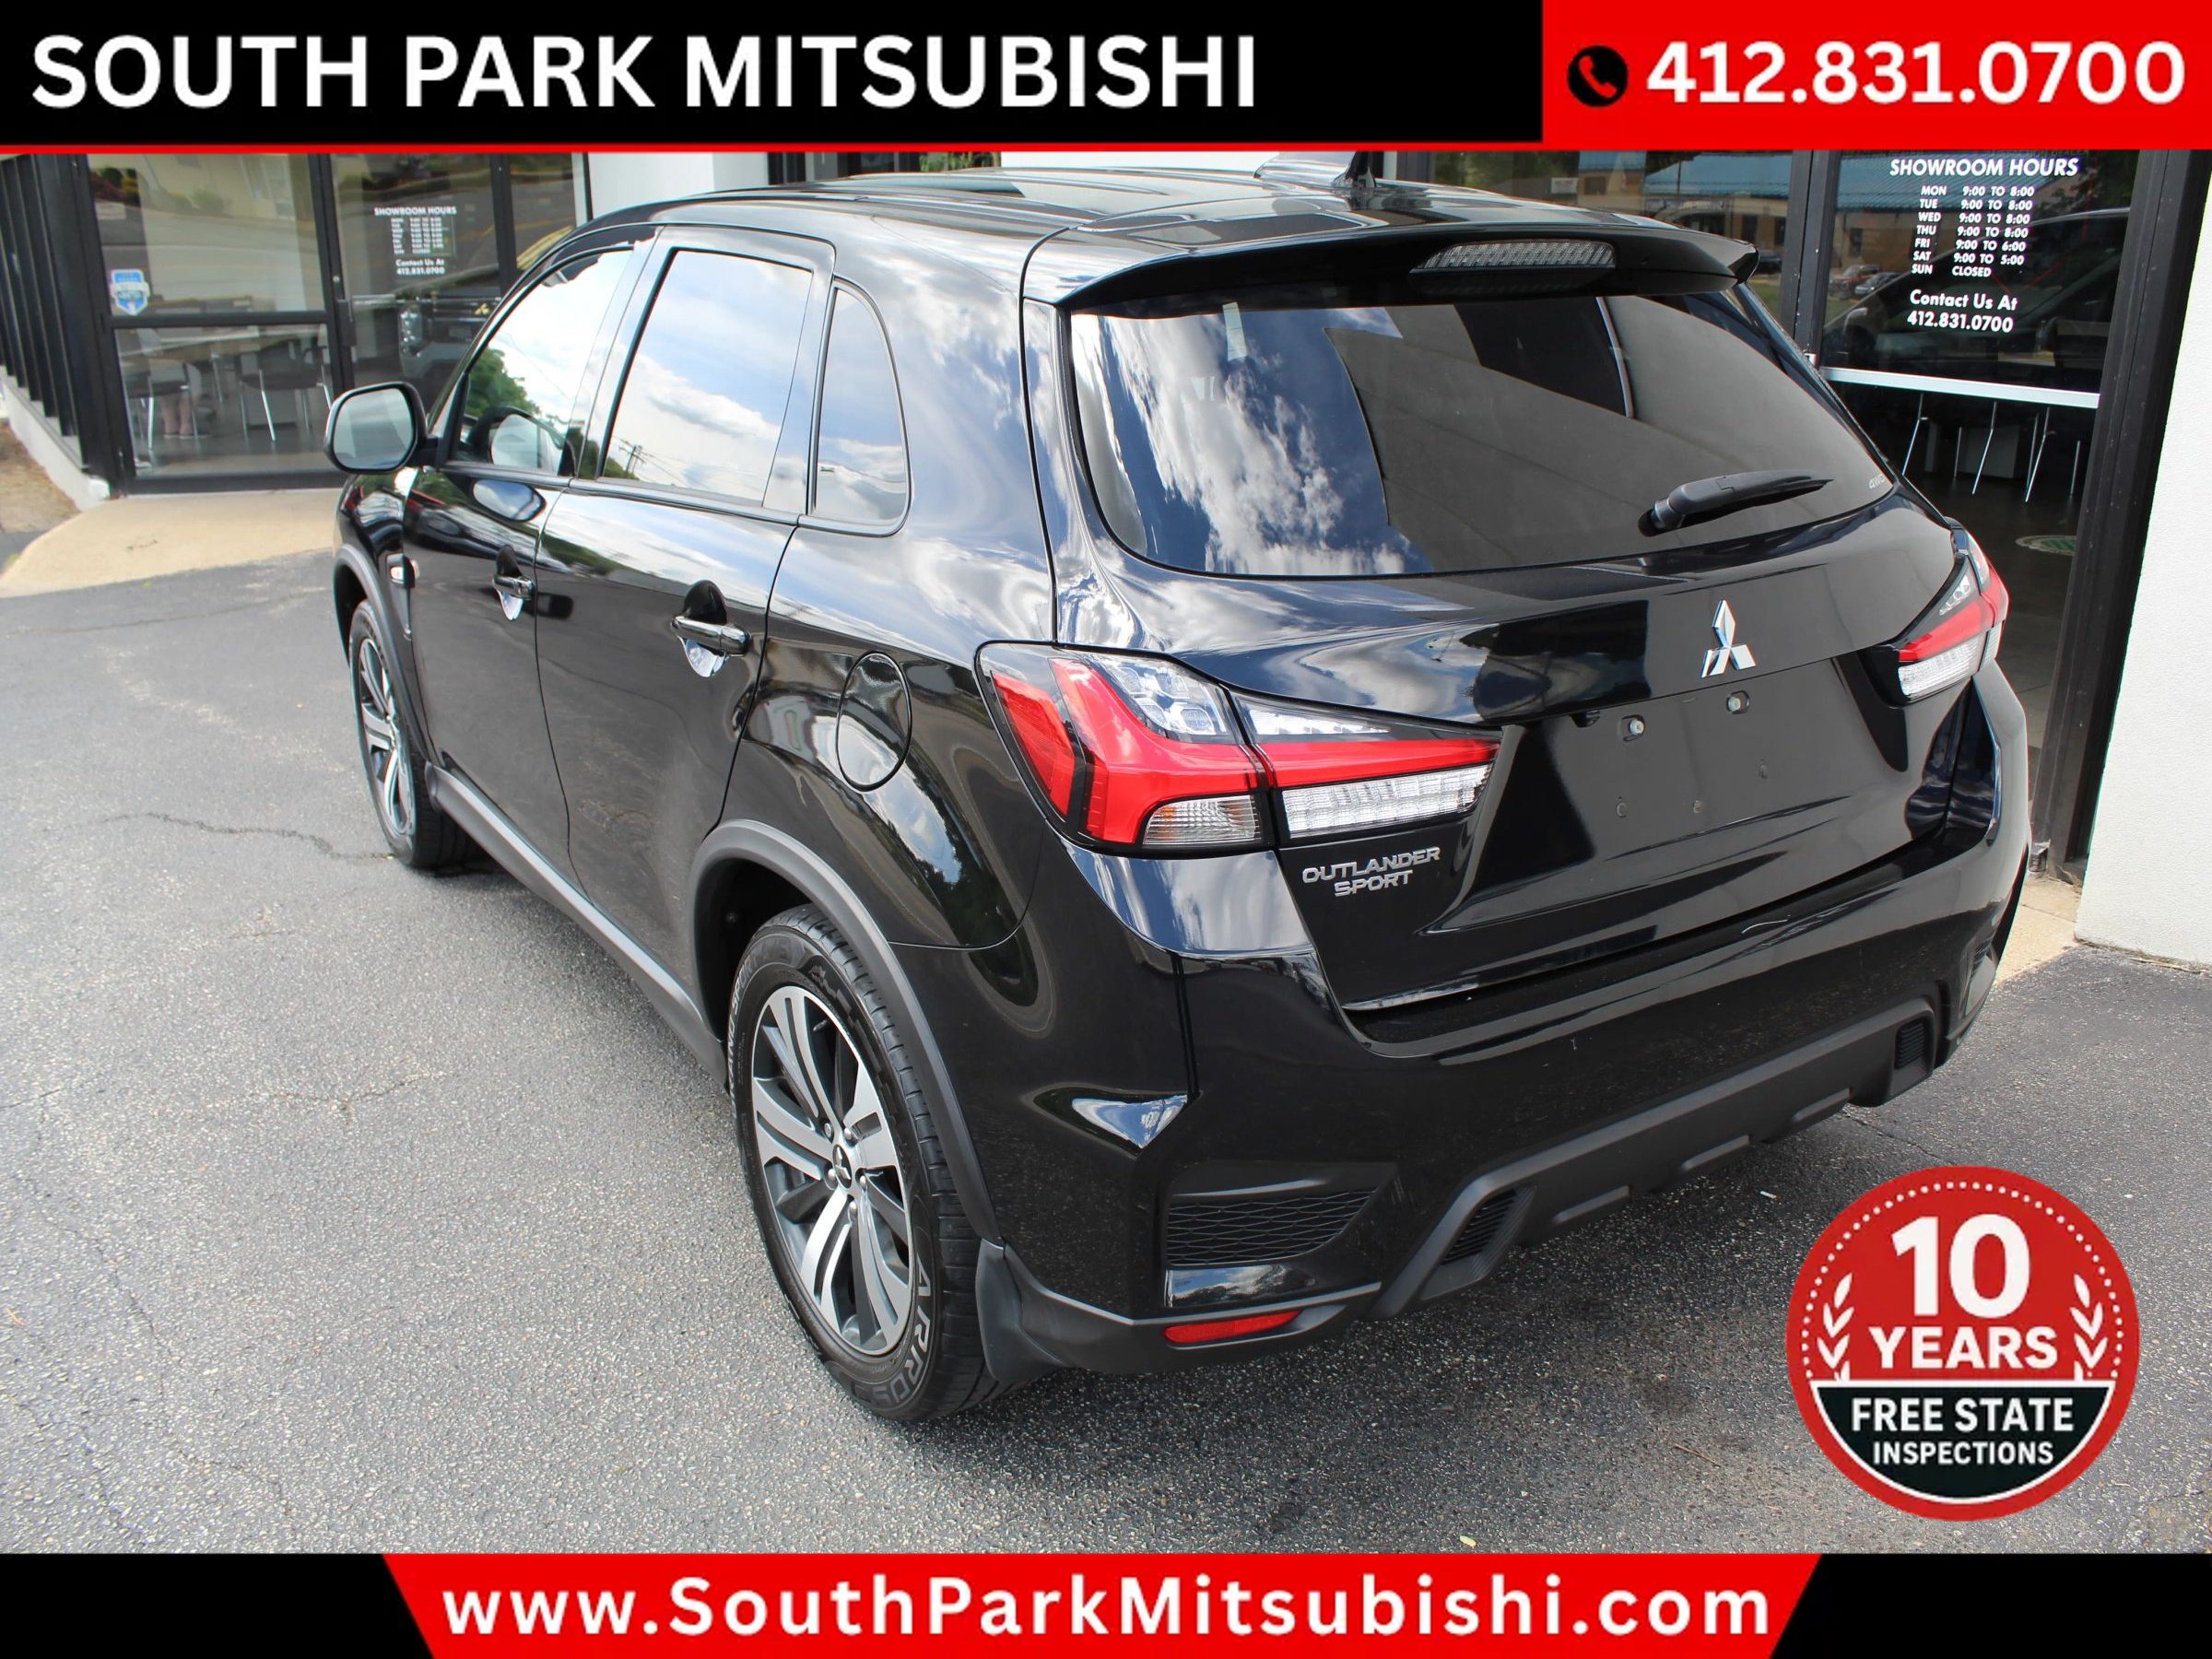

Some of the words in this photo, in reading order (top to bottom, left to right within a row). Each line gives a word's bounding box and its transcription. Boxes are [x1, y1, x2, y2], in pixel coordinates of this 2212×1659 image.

[1889, 158, 2004, 176] SHOWROOM
[2009, 157, 2079, 176] HOURS
[1921, 185, 1947, 195] MON
[1962, 186, 1985, 196] 9:00
[1991, 186, 2006, 196] TO
[2010, 186, 2035, 196] 8:00
[374, 206, 426, 216] SHOWROOM
[428, 206, 457, 215] HOURS
[1920, 198, 1938, 208] TUE
[1960, 199, 1983, 210] 9:00
[1988, 200, 2003, 210] TO
[2008, 200, 2032, 210] 8:00
[1918, 212, 1941, 222] WED
[1959, 213, 1982, 223] 9:00
[1986, 213, 2001, 224] TO
[2006, 214, 2030, 224] 8:00
[1916, 225, 1936, 235] THU
[1957, 226, 1980, 236] 9:00
[1985, 227, 1999, 237] TO
[2004, 227, 2029, 238] 8:00
[1914, 238, 1930, 248] FRI
[1955, 240, 1978, 250] 9:00
[1983, 241, 1997, 251] TO
[2001, 241, 2026, 252] 6:00
[1912, 251, 1932, 261] SAT
[1953, 253, 1976, 263] 9:00
[1979, 253, 1994, 264] TO
[2000, 255, 2024, 265] 5:00
[1911, 264, 1933, 275] SUN
[1952, 265, 1992, 277] CLOSED
[1910, 288, 1969, 308] Contact
[1972, 291, 1993, 310] Us
[1997, 294, 2018, 312] At
[1907, 311, 2014, 333] 412.831.0700
[1301, 846, 1441, 884] OUTLANDER
[1334, 869, 1414, 897] SPORT
